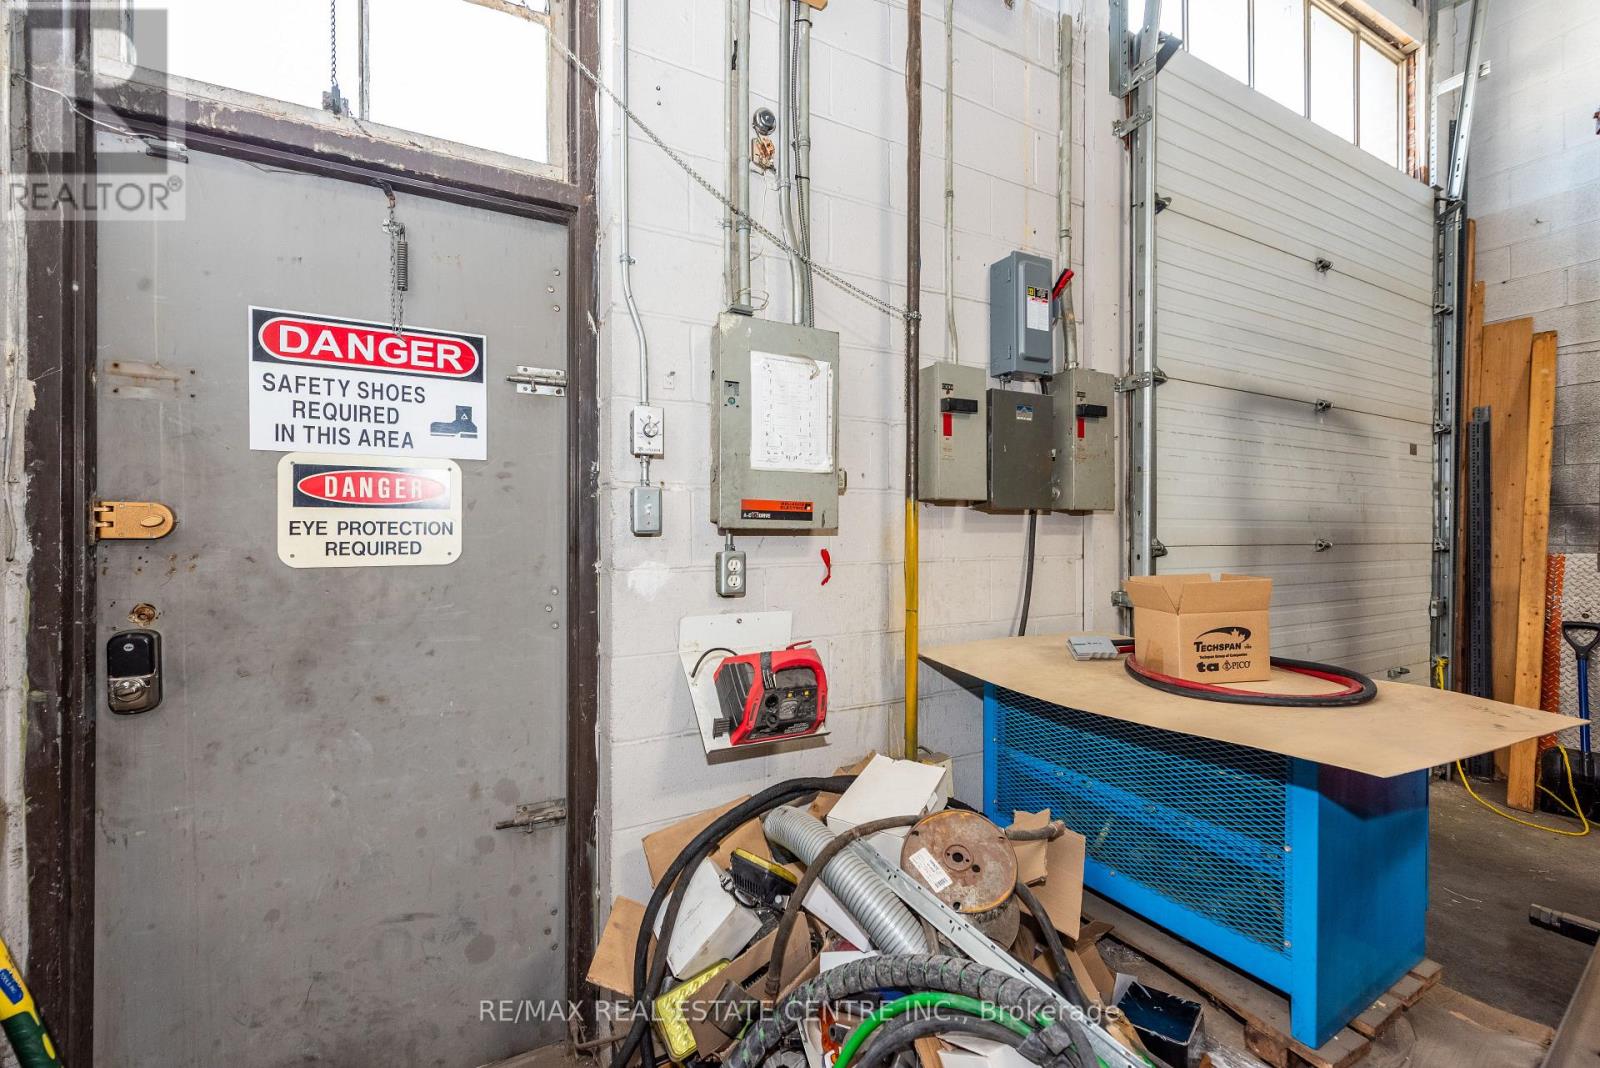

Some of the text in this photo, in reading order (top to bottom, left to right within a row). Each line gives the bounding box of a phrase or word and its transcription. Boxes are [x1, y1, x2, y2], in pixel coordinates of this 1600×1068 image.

[279, 324, 464, 371] DANGER
[262, 372, 426, 404] SAFETY SHOES
[292, 399, 399, 425] REQUIRED
[275, 423, 414, 449] IN THIS AREA
[324, 475, 423, 499] DANGER
[289, 520, 454, 536] EYE PROTECTION
[325, 540, 422, 557] REQUIRED
[1193, 641, 1242, 652] TECHSPAN
